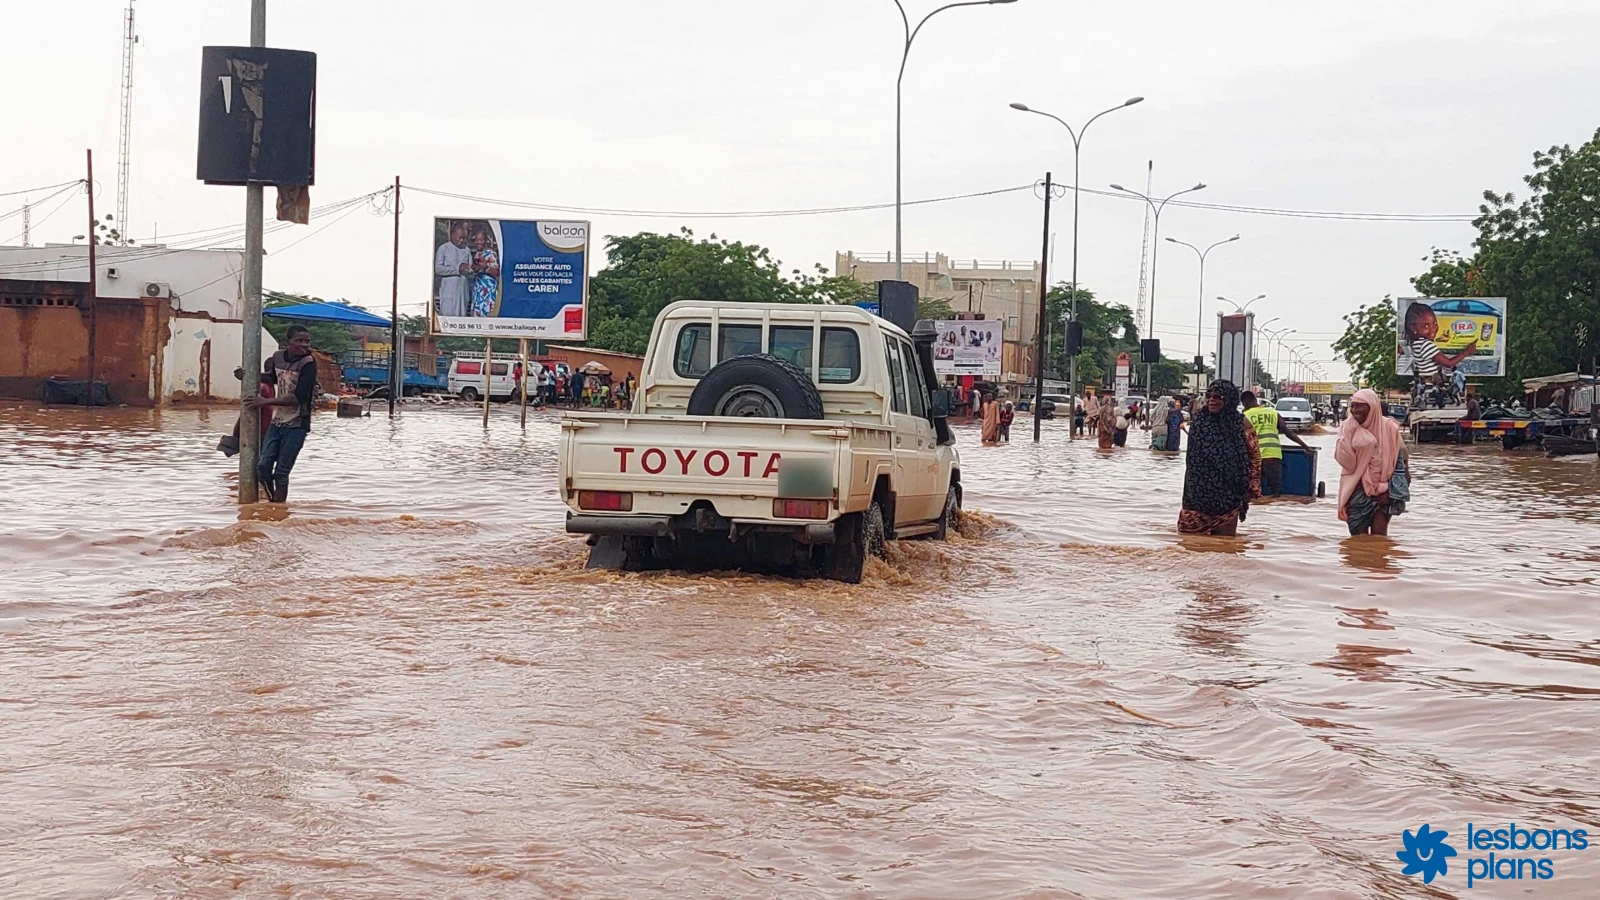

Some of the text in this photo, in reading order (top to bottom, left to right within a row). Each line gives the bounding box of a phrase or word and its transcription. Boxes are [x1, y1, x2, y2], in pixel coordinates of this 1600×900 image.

[544, 224, 585, 236] baloon
[528, 284, 559, 293] CAREN
[1250, 413, 1274, 425] CENI
[613, 447, 783, 478] TOYOTA
